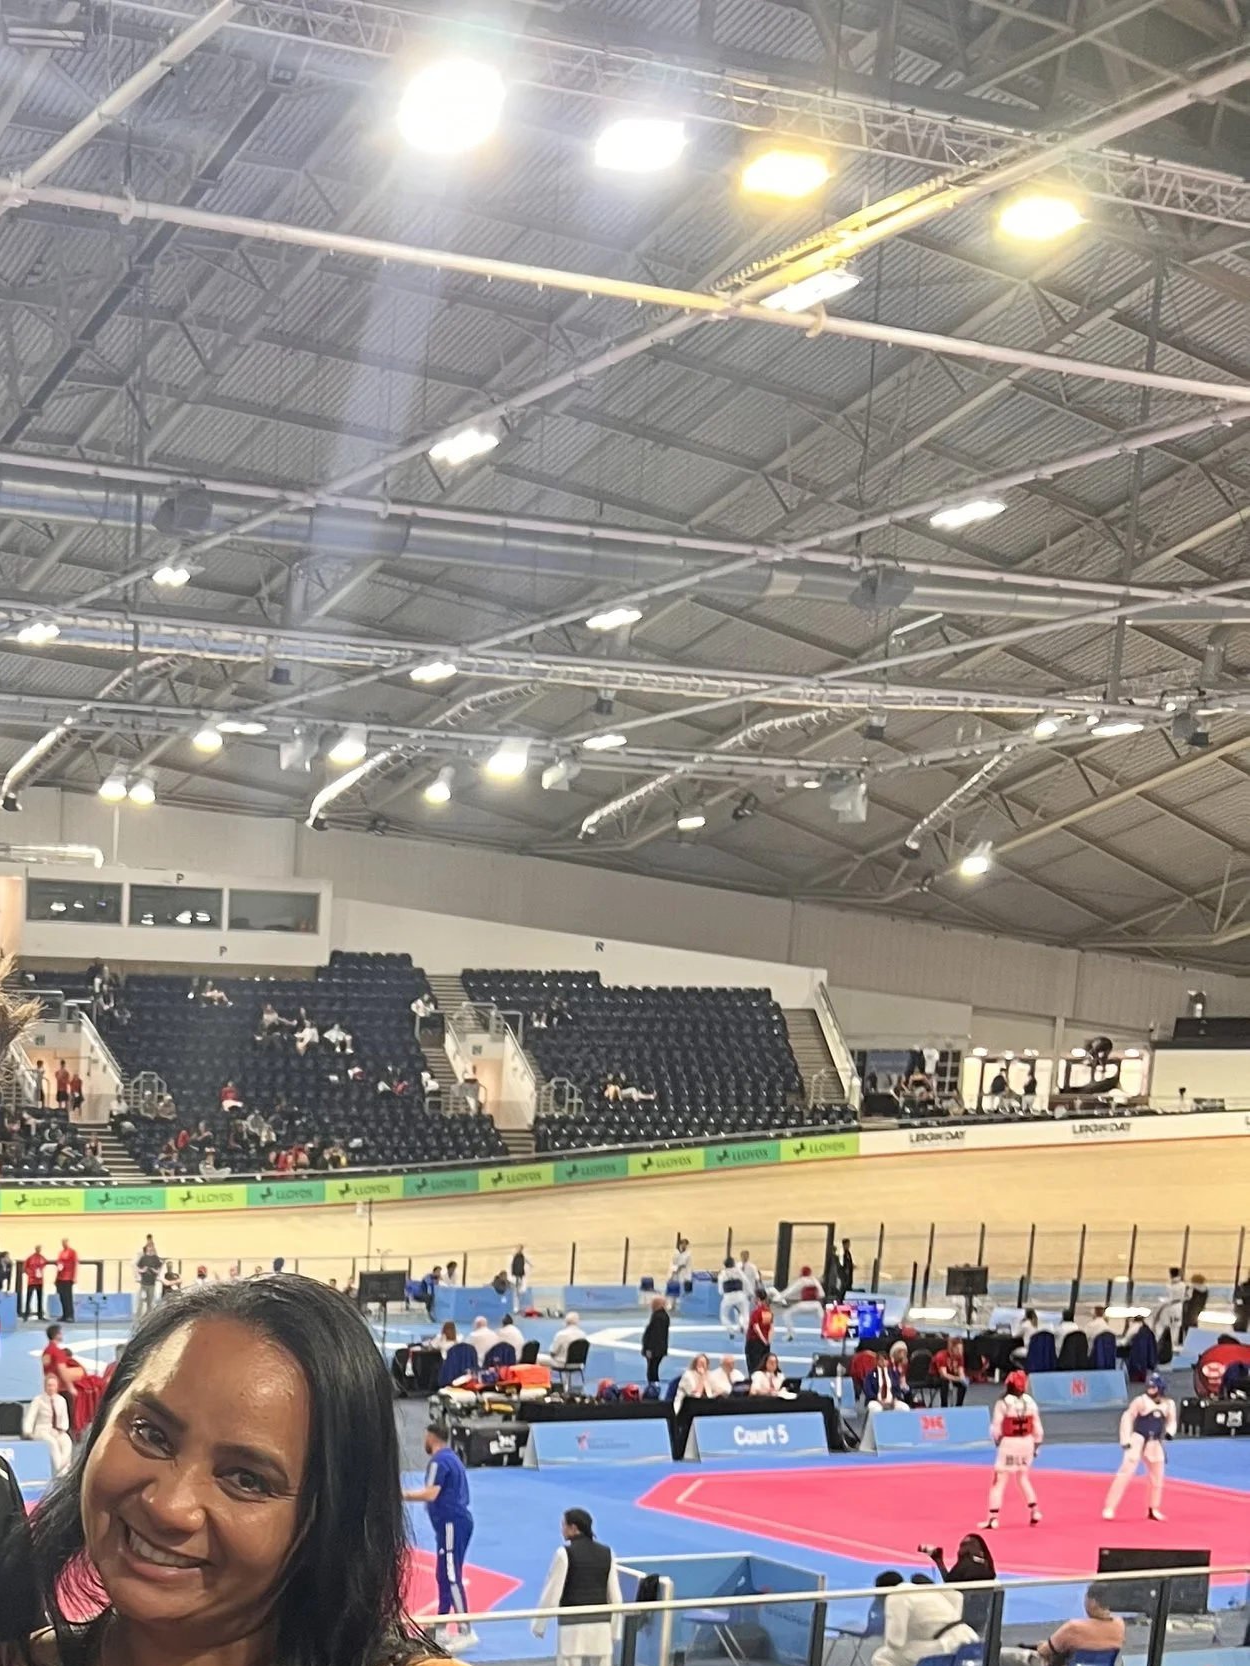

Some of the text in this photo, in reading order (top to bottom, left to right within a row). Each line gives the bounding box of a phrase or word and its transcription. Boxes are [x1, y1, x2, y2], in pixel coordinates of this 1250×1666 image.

[176, 873, 184, 883] P
[219, 946, 227, 956] P
[595, 941, 604, 952] R
[31, 1196, 71, 1207] LLOYDS
[733, 1423, 790, 1446] Court 5
